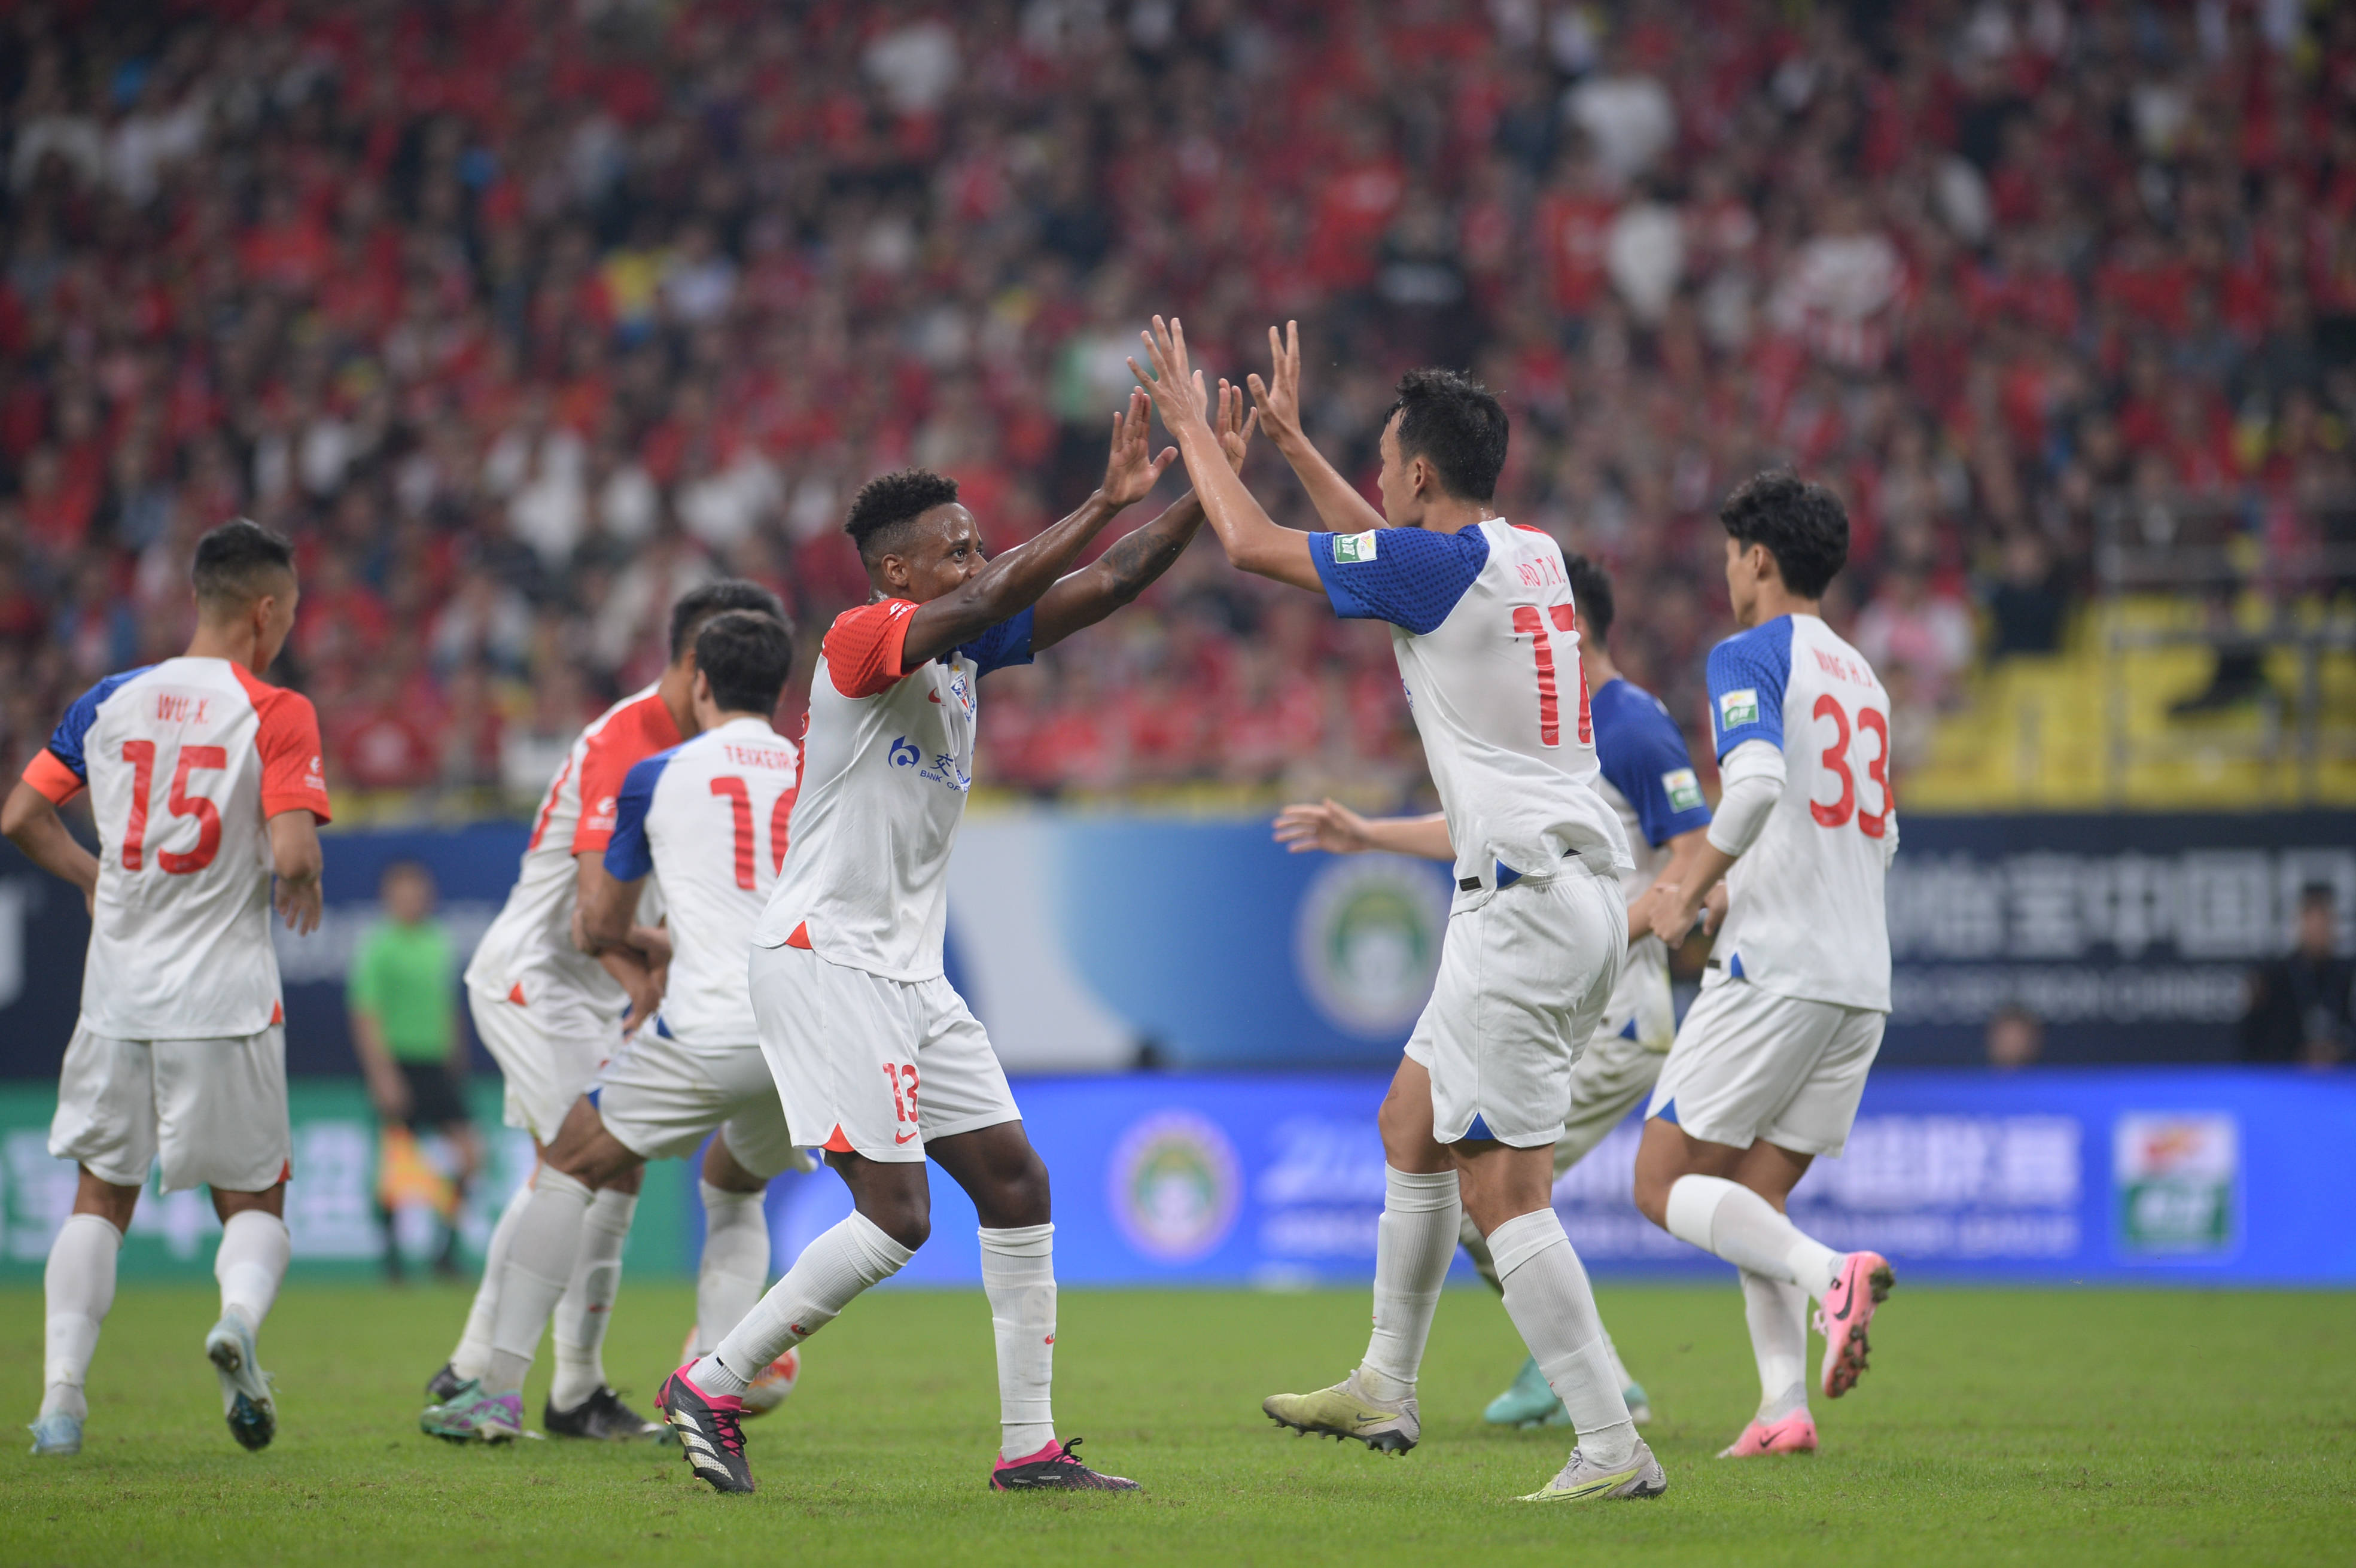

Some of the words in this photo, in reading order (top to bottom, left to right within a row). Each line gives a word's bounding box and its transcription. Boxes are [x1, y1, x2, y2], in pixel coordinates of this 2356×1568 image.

[157, 693, 190, 723] WU
[920, 769, 942, 783] BANK
[946, 781, 961, 791] OF
[1810, 694, 1888, 839] 33
[122, 739, 226, 875] 15
[882, 1062, 920, 1123] 13
